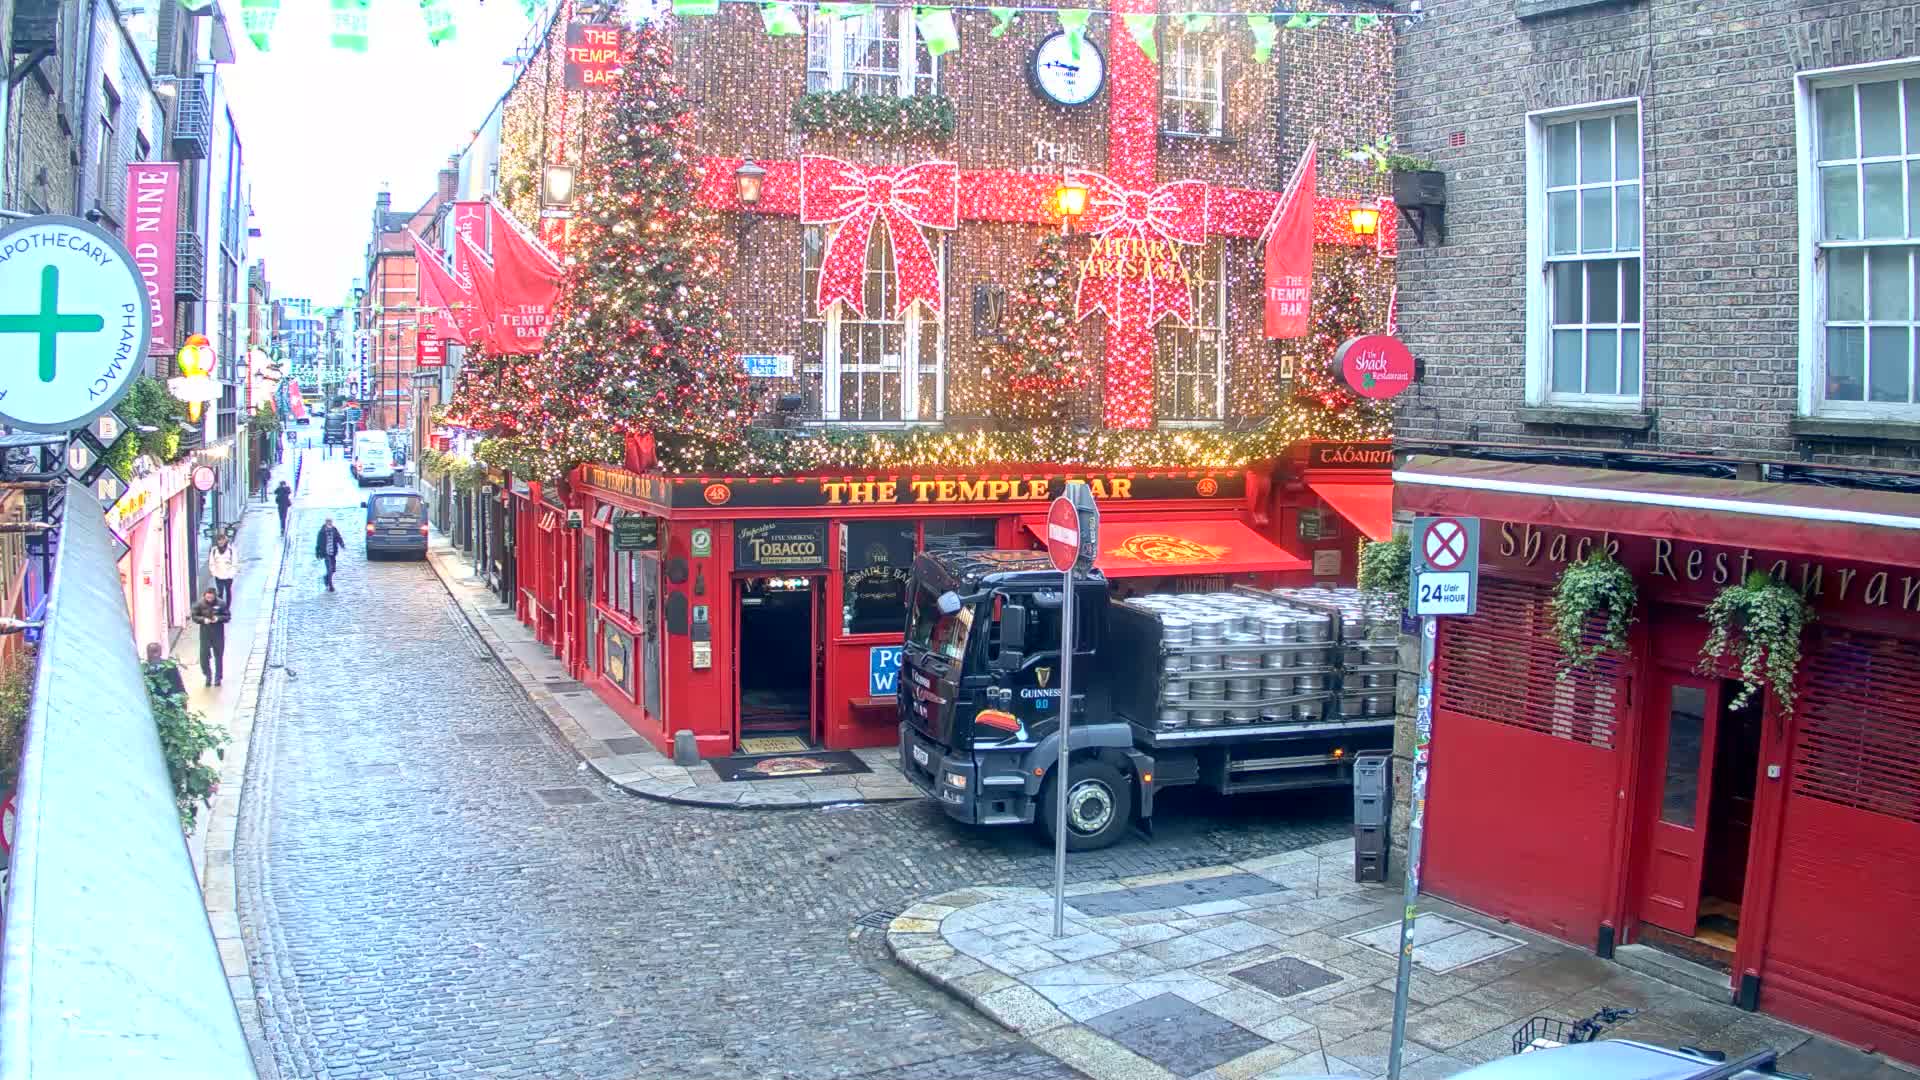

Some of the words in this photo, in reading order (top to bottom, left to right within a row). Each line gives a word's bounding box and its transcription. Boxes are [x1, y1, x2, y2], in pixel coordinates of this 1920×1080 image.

[584, 29, 618, 45] THE
[568, 47, 625, 63] TEMPL
[136, 171, 169, 233] NINE
[0, 233, 112, 267] APOTHECARY
[1286, 276, 1303, 286] THE
[1270, 287, 1310, 301] TEMPL
[519, 304, 545, 314] THE
[1280, 303, 1303, 316] BAR
[500, 314, 554, 326] TEMPL
[516, 327, 548, 338] BAR
[88, 303, 136, 401] PHARMACY
[593, 468, 606, 488] THE
[606, 470, 633, 495] TEMPLE
[635, 475, 652, 499] BAR
[708, 487, 726, 500] 48
[823, 481, 898, 505] THE
[912, 479, 1049, 502] TEMPLE
[1066, 479, 1132, 498] AR
[752, 538, 816, 562] TOBACCO
[1500, 520, 1619, 566] Shack
[1421, 584, 1442, 602] 24
[1443, 594, 1466, 603] HOUR
[1020, 688, 1063, 698] GUINNESS
